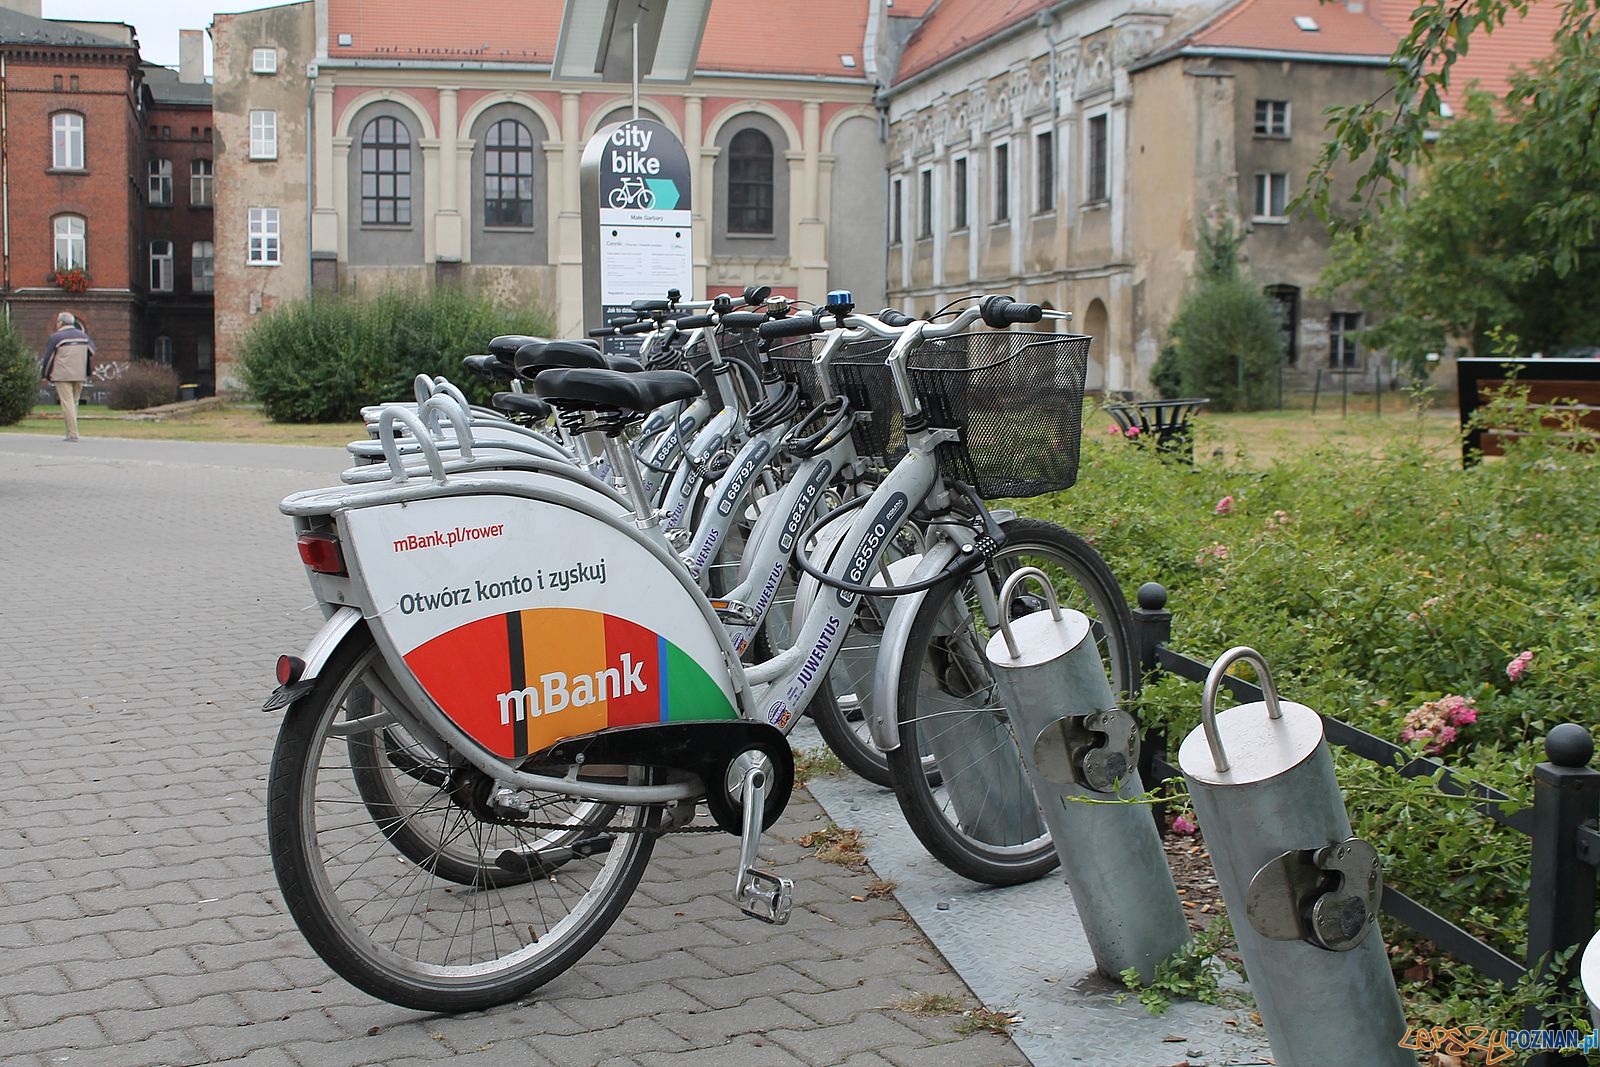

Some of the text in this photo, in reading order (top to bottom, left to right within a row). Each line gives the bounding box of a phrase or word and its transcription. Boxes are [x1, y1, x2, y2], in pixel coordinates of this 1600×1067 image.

[611, 124, 652, 152] city
[612, 150, 661, 174] bike
[658, 433, 678, 461] 6849
[727, 460, 756, 500] 68792
[788, 485, 816, 533] 68418
[393, 523, 504, 552] mBank.pl/rower
[691, 528, 719, 578] UWENTUS
[850, 523, 886, 582] 68550
[399, 558, 606, 615] Otwórz konto i zyskuj
[755, 561, 783, 616] UWENTUS
[797, 615, 840, 688] JUWENTUS
[496, 652, 648, 726] mBank
